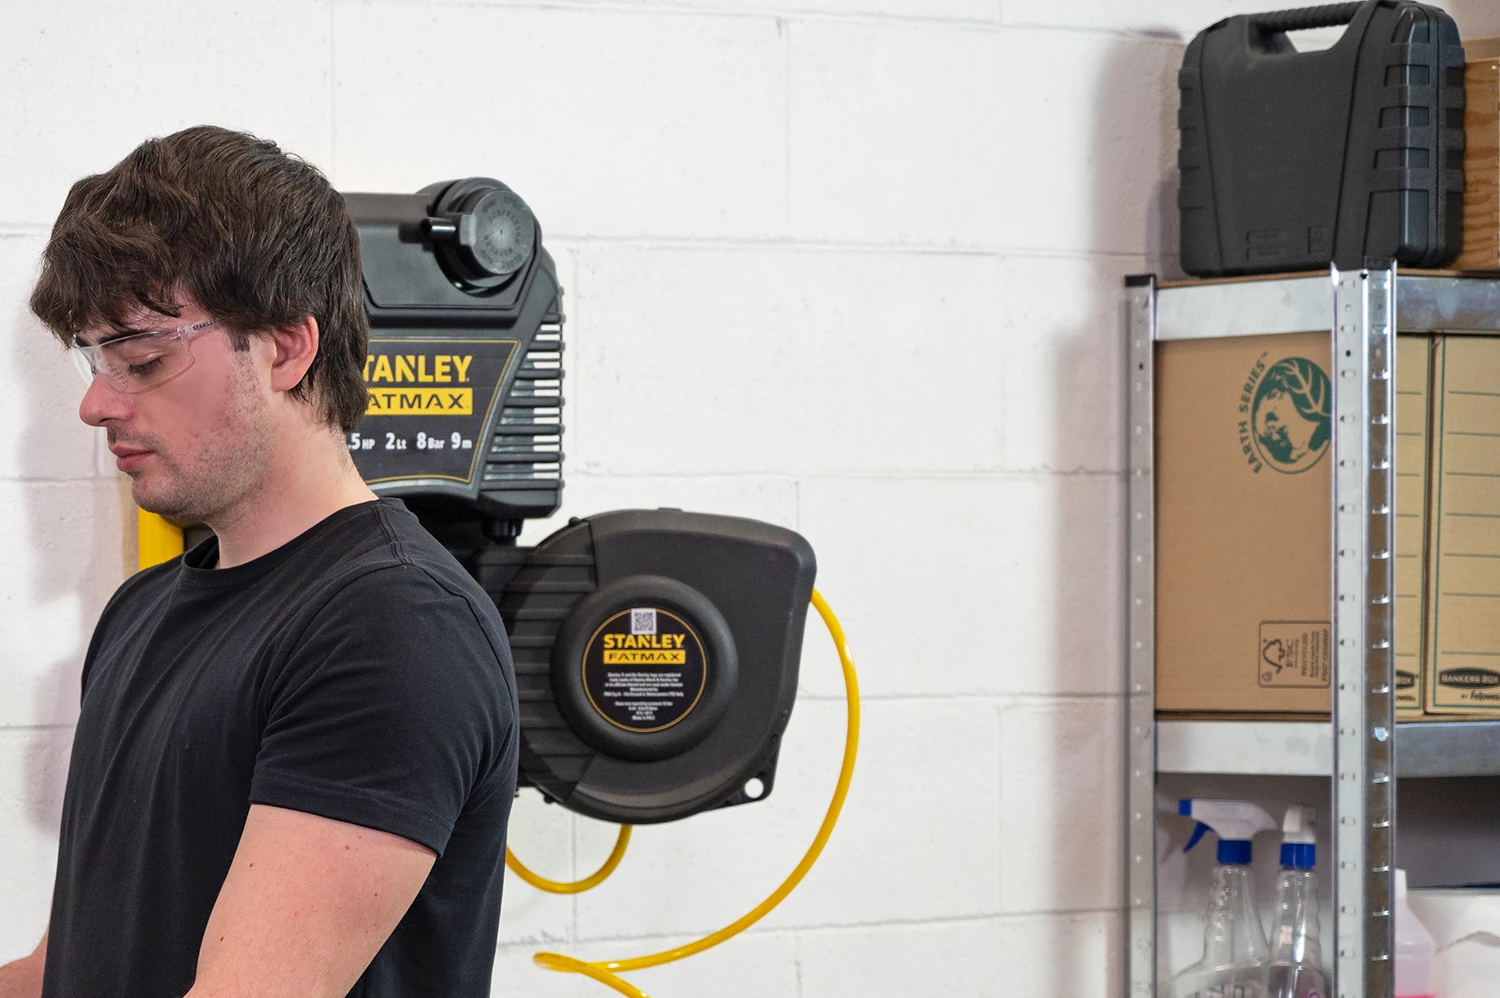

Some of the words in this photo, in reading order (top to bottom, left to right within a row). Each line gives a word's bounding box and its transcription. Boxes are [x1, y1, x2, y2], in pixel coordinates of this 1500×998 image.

[362, 355, 473, 382] TANLEY
[368, 394, 464, 409] ATMAX
[1238, 421, 1262, 474] EARTH
[603, 633, 685, 649] STANLEY
[608, 652, 680, 661] FATMAX
[1441, 673, 1480, 683] BANKERS
[1481, 674, 1499, 684] BOX
